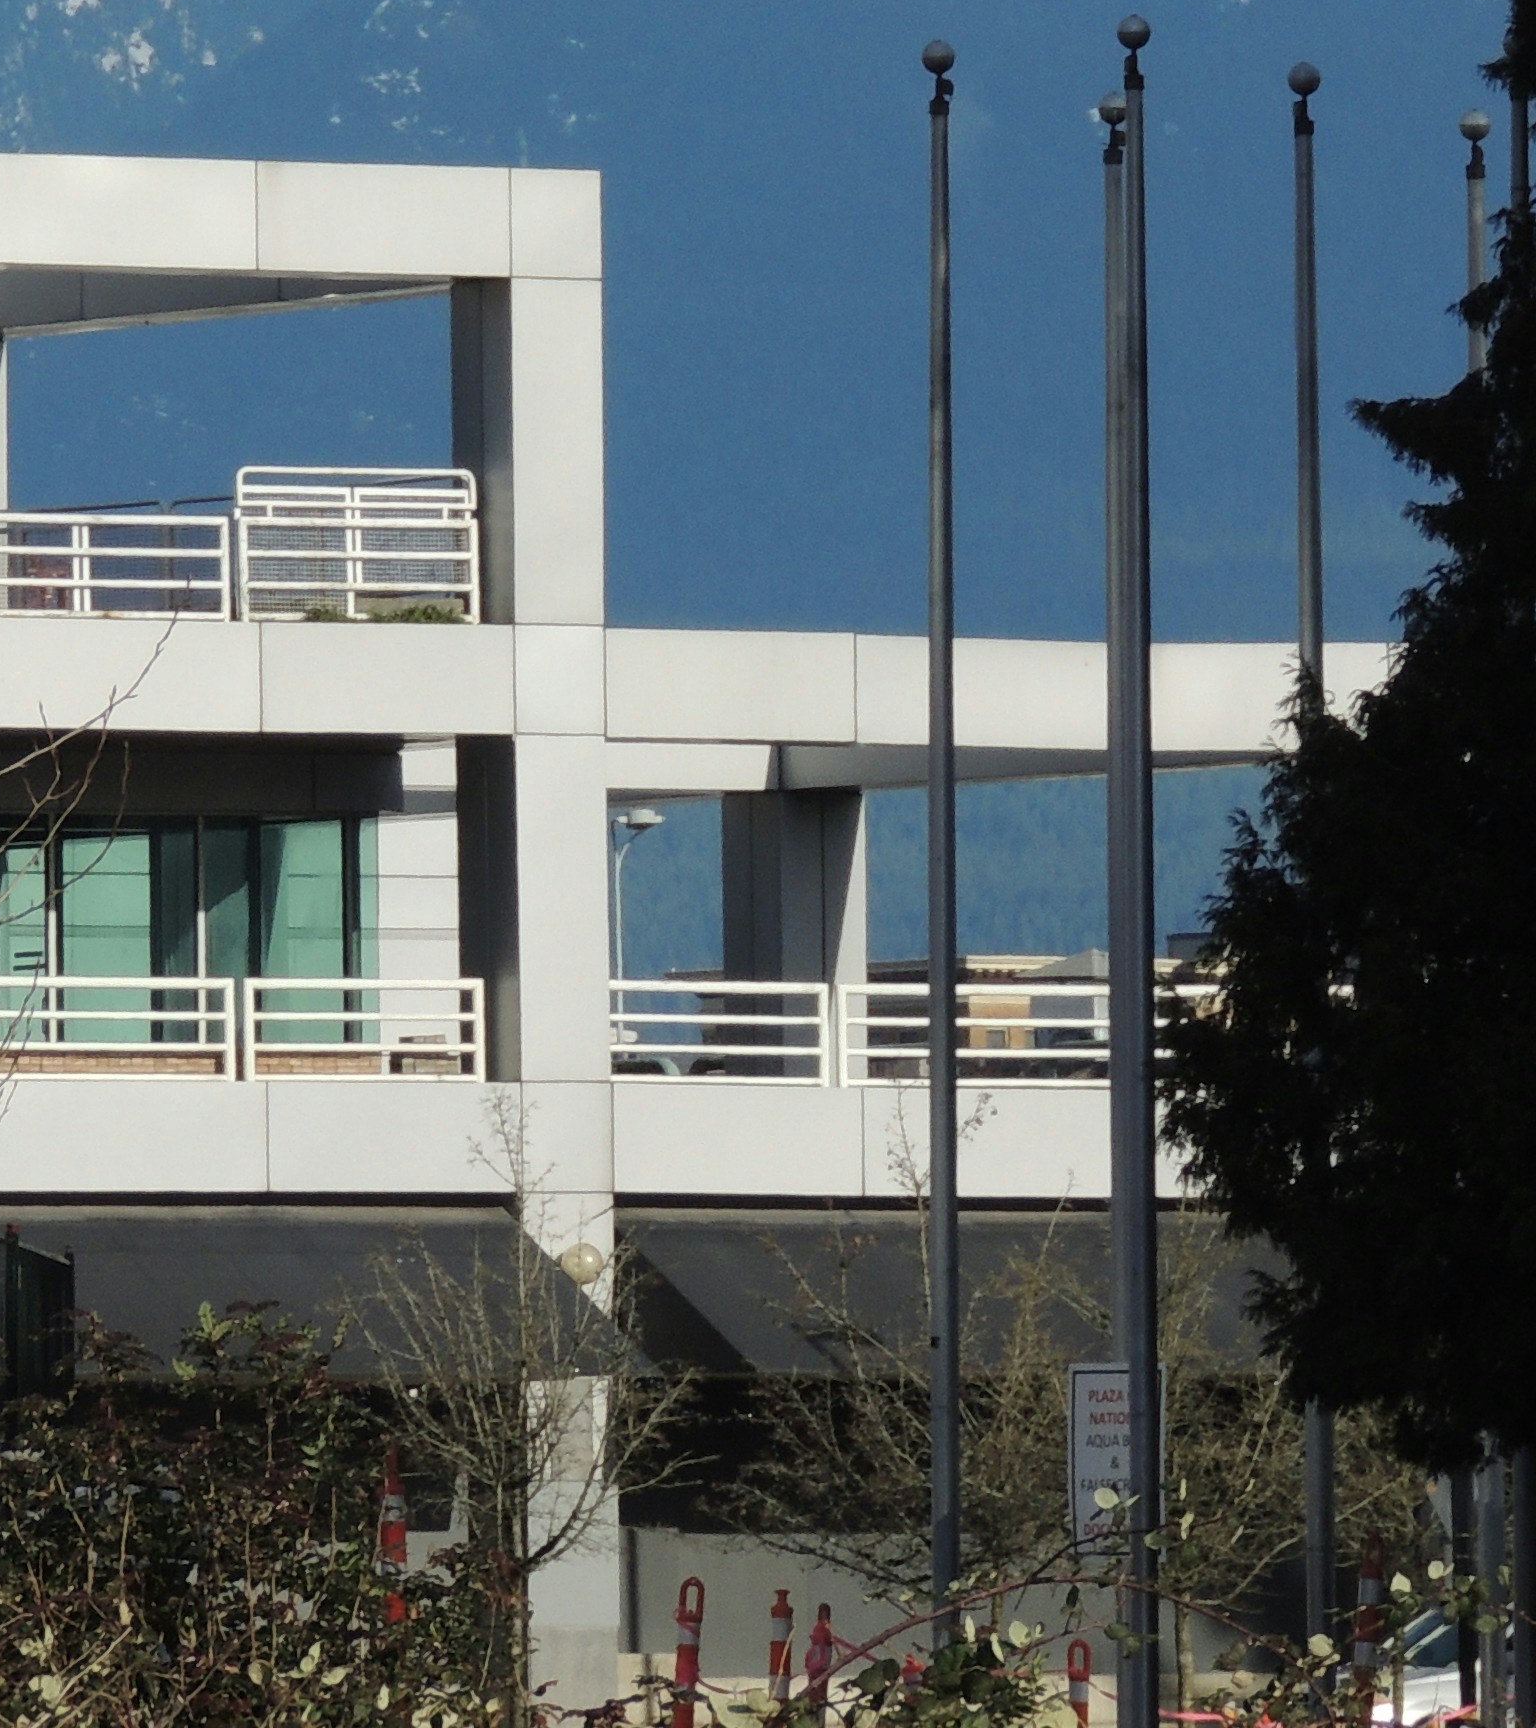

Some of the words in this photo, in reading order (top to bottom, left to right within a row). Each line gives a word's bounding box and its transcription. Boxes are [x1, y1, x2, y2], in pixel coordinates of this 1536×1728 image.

[1088, 1389, 1123, 1403] PLAZA
[1086, 1434, 1119, 1448] AQUA
[1110, 1456, 1119, 1469] &
